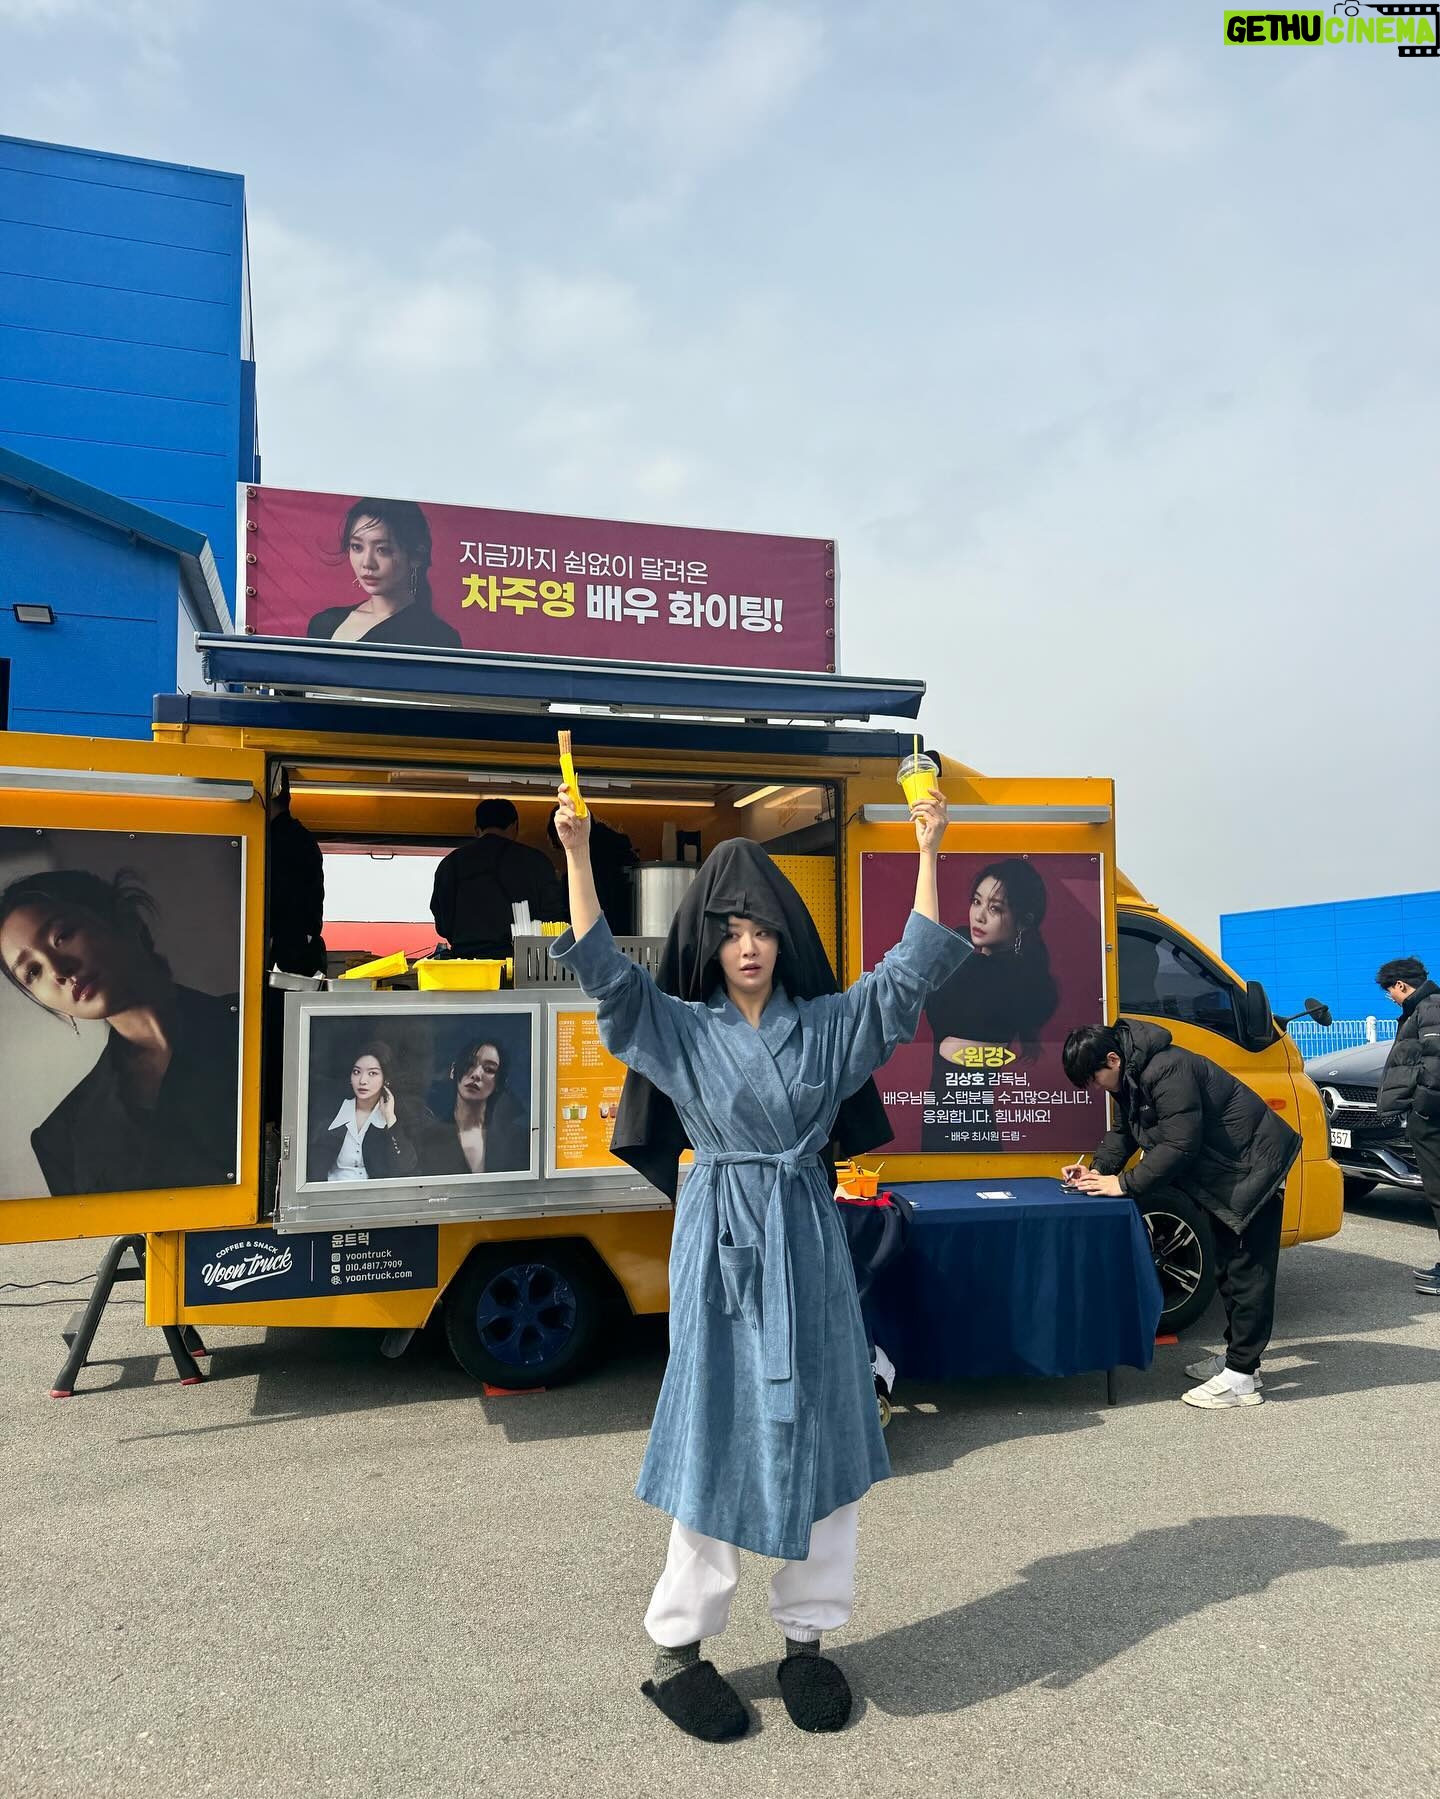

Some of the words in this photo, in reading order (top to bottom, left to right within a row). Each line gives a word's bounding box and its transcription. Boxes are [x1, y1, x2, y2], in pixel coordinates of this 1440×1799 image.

[459, 540, 556, 573] 지금까지
[563, 550, 634, 579] 쉼없이
[640, 557, 709, 585] 달려온
[460, 573, 576, 619] 차주영
[586, 584, 659, 624] 배우
[668, 590, 784, 633] 화이팅!
[945, 1072, 985, 1087] 김상호
[988, 1072, 1031, 1087] 감독님,
[883, 1091, 939, 1105] 배우님들,
[942, 1091, 995, 1105] 스탭분들
[997, 1090, 1093, 1105] 수고많으십니다.
[923, 1109, 992, 1124] 응원합니다.
[995, 1109, 1051, 1123] 힘내세요!
[951, 1131, 970, 1141] 배우
[972, 1131, 999, 1141] 최시원
[1001, 1131, 1020, 1141] 드림
[331, 1232, 370, 1248] 윤트럭
[216, 1241, 245, 1259] COFFEE
[253, 1241, 278, 1254] SNACK
[345, 1250, 392, 1261] yoontruck
[345, 1260, 403, 1272] 010.4817.7909
[345, 1270, 413, 1283] yoontruck.com
